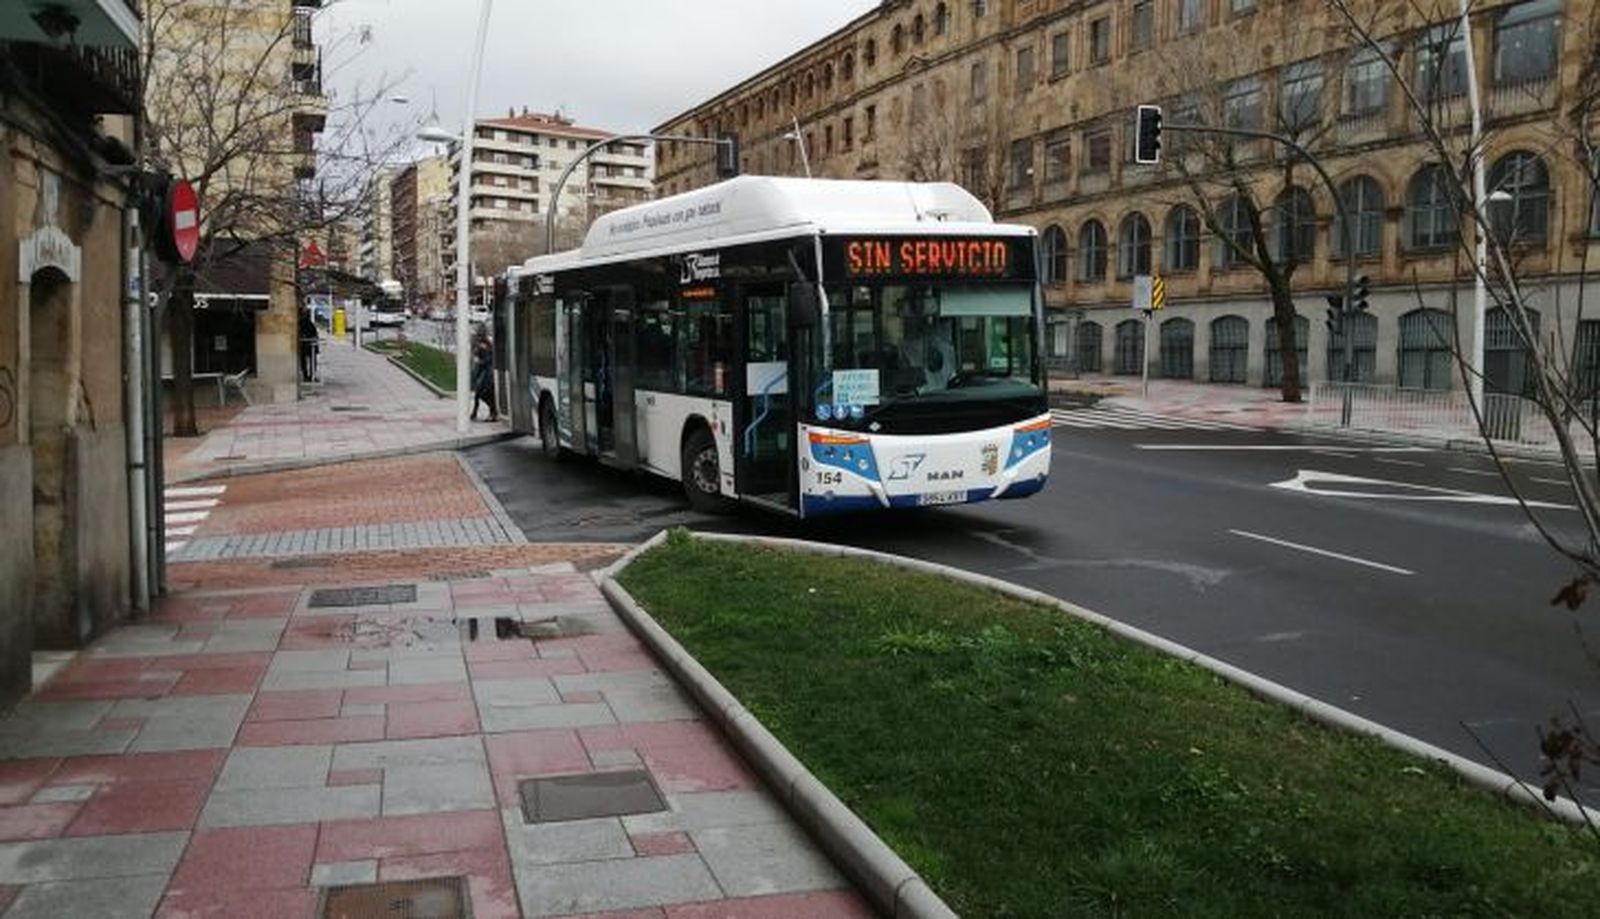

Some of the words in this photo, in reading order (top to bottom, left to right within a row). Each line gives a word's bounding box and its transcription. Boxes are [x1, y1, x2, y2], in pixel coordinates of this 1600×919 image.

[848, 240, 892, 273] SIN
[900, 240, 1007, 273] SERVICIO
[816, 471, 842, 485] 154
[926, 469, 964, 482] MAN
